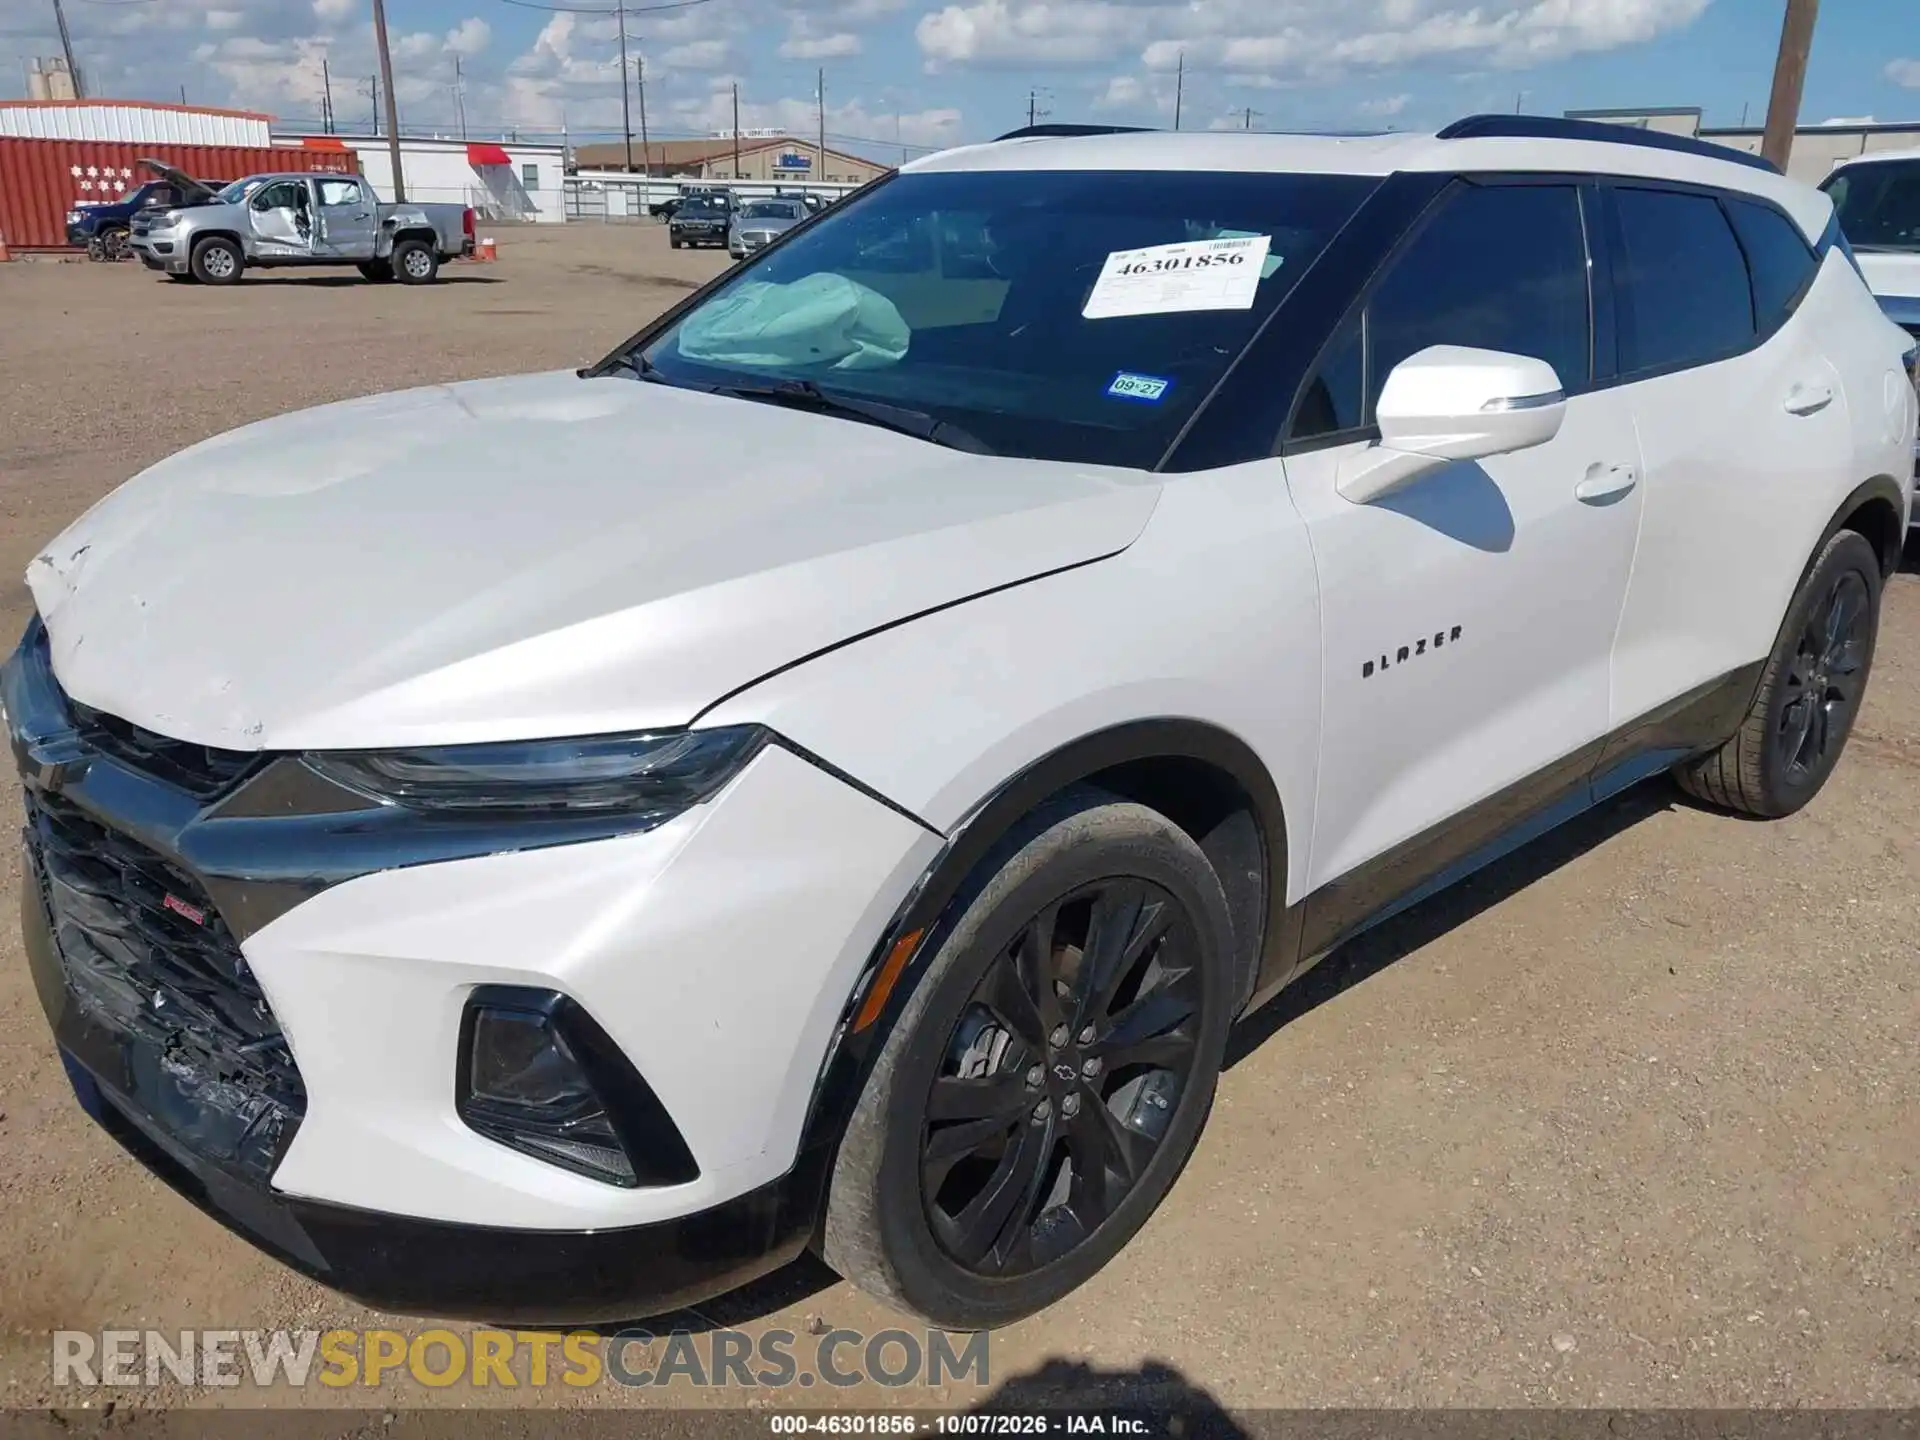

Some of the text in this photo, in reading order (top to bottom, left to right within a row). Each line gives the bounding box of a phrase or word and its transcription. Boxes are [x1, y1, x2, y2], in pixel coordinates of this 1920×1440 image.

[1117, 252, 1244, 276] 46301856
[1114, 379, 1136, 391] 09
[1139, 383, 1162, 395] 27
[1362, 625, 1462, 679] BLAZER
